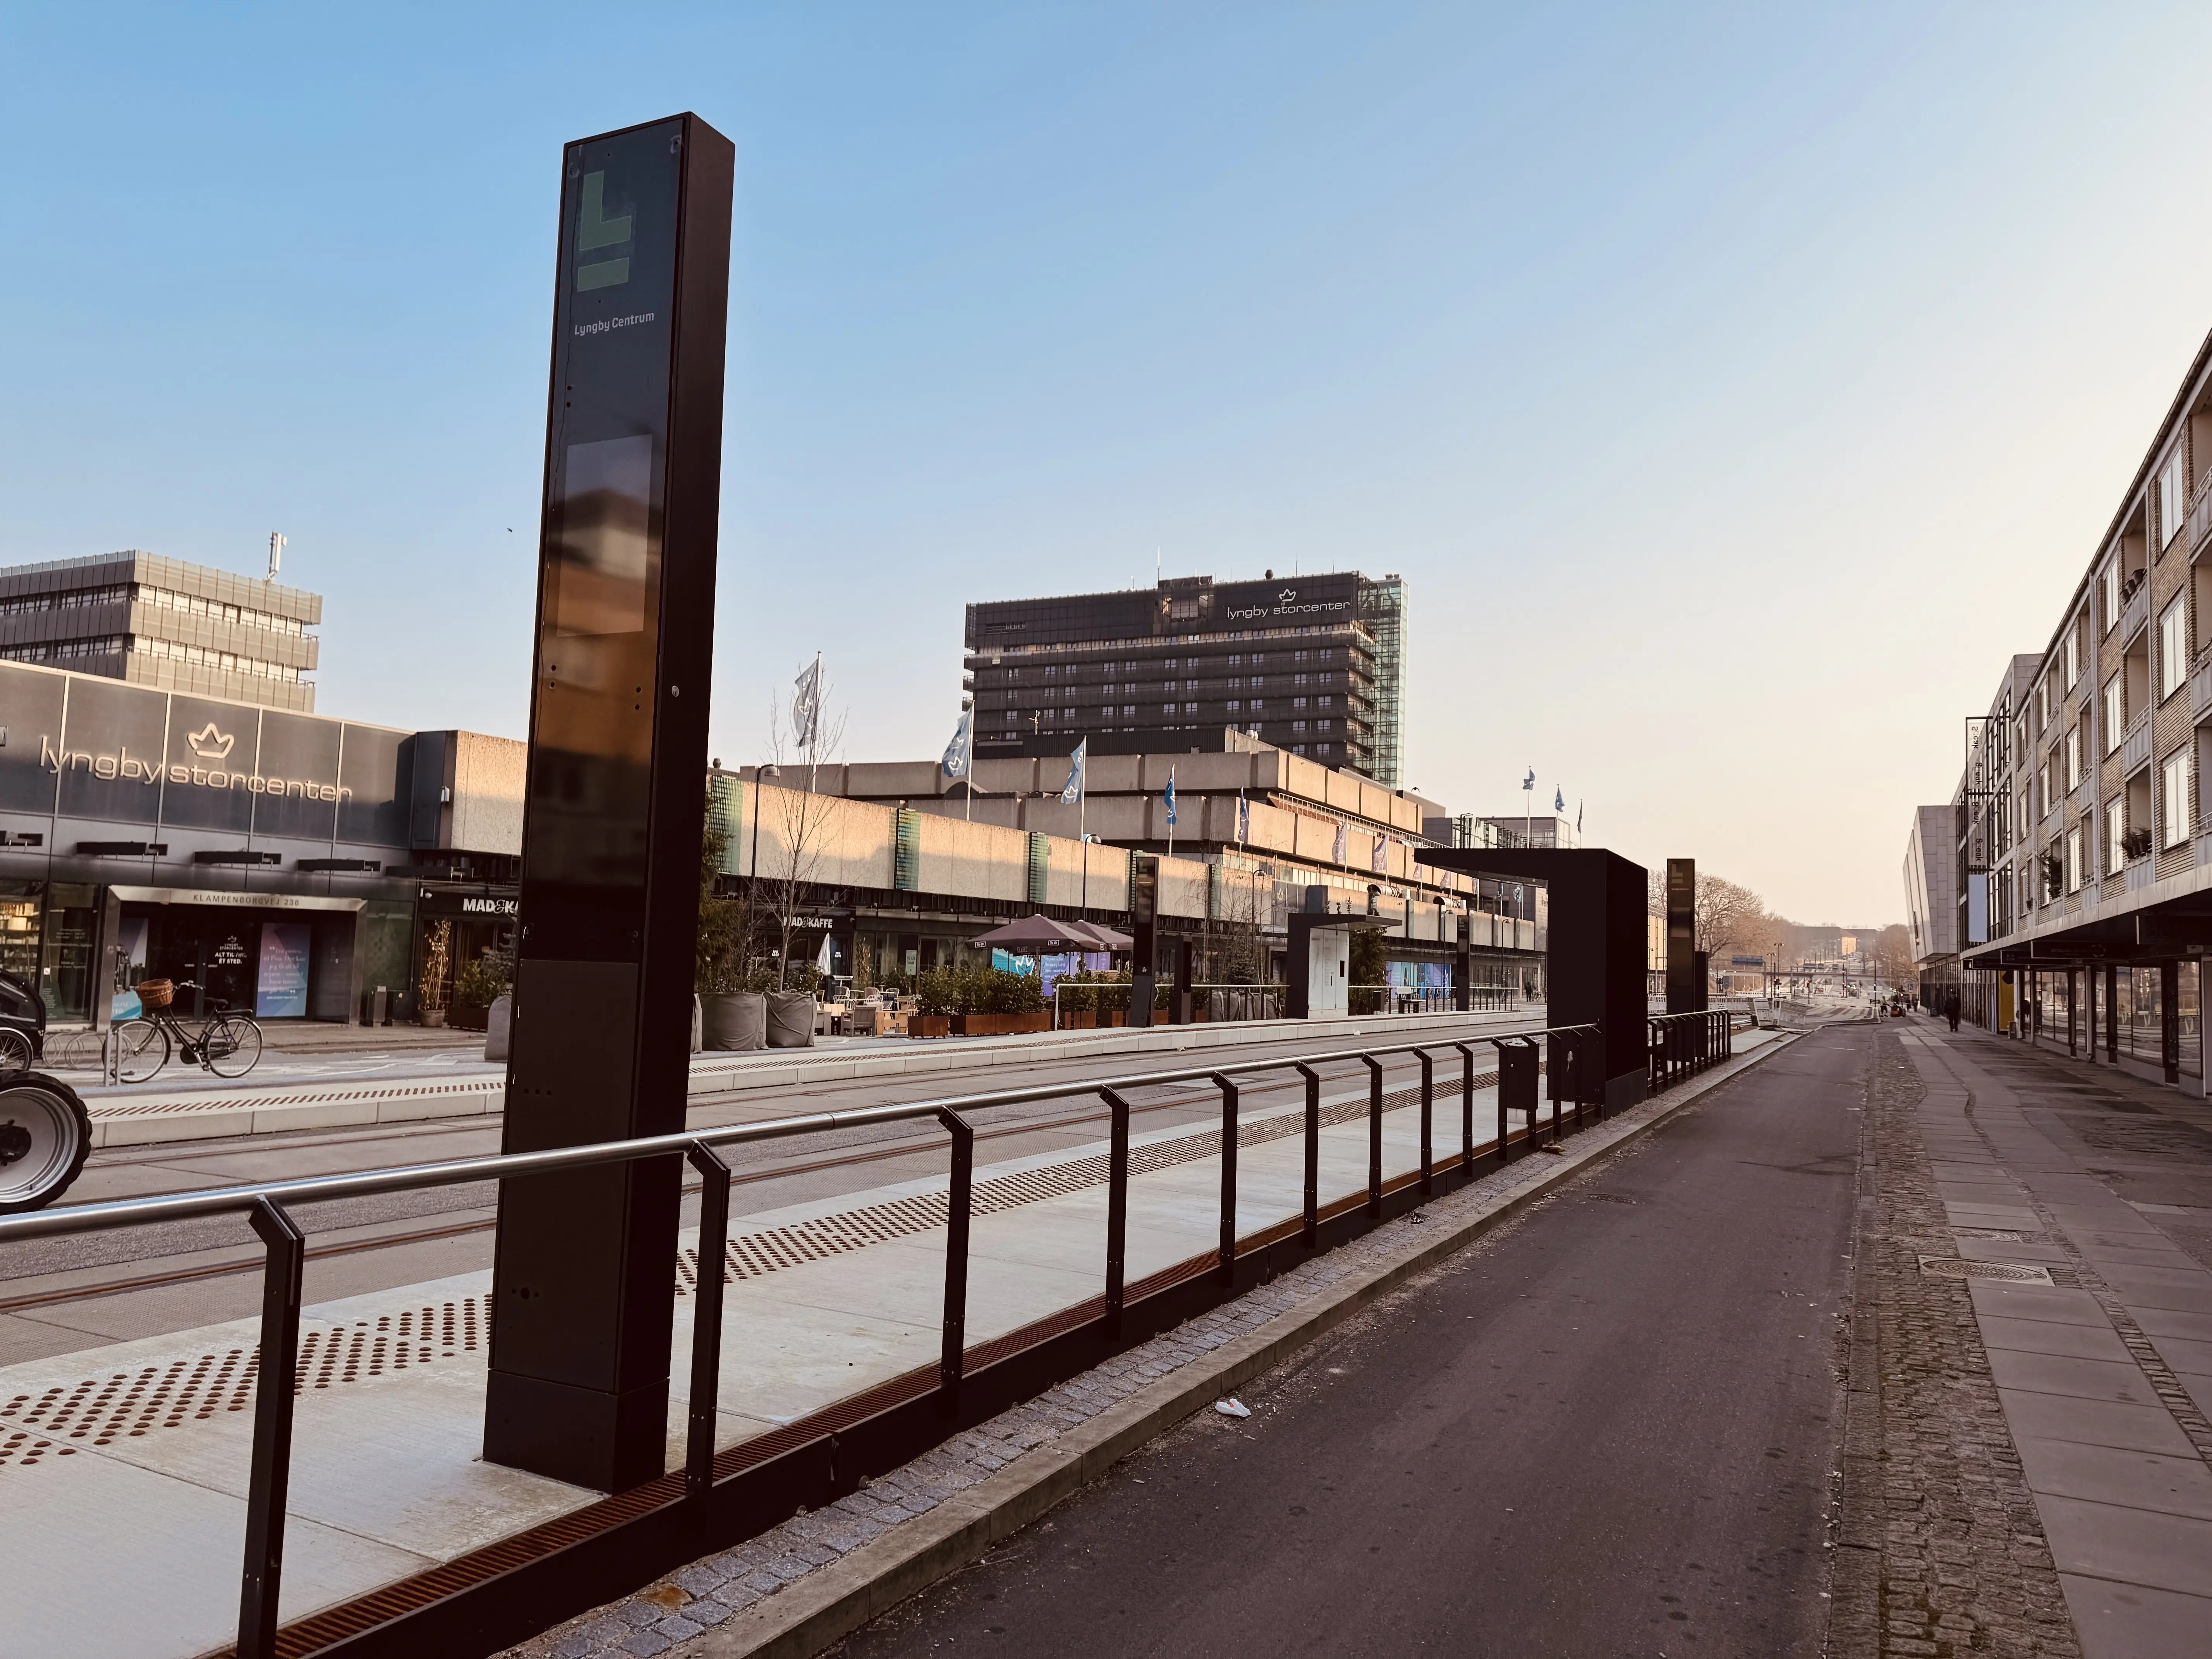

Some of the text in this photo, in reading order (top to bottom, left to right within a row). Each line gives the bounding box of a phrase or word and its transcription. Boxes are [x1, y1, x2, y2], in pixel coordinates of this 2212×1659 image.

[575, 313, 654, 336] Lyngby Centrum
[1227, 601, 1350, 620] lyngby storcenter
[40, 736, 352, 803] lyngby storcenter
[194, 894, 280, 905] KLAMPENBORGVEJ
[463, 898, 518, 914] MAD&K
